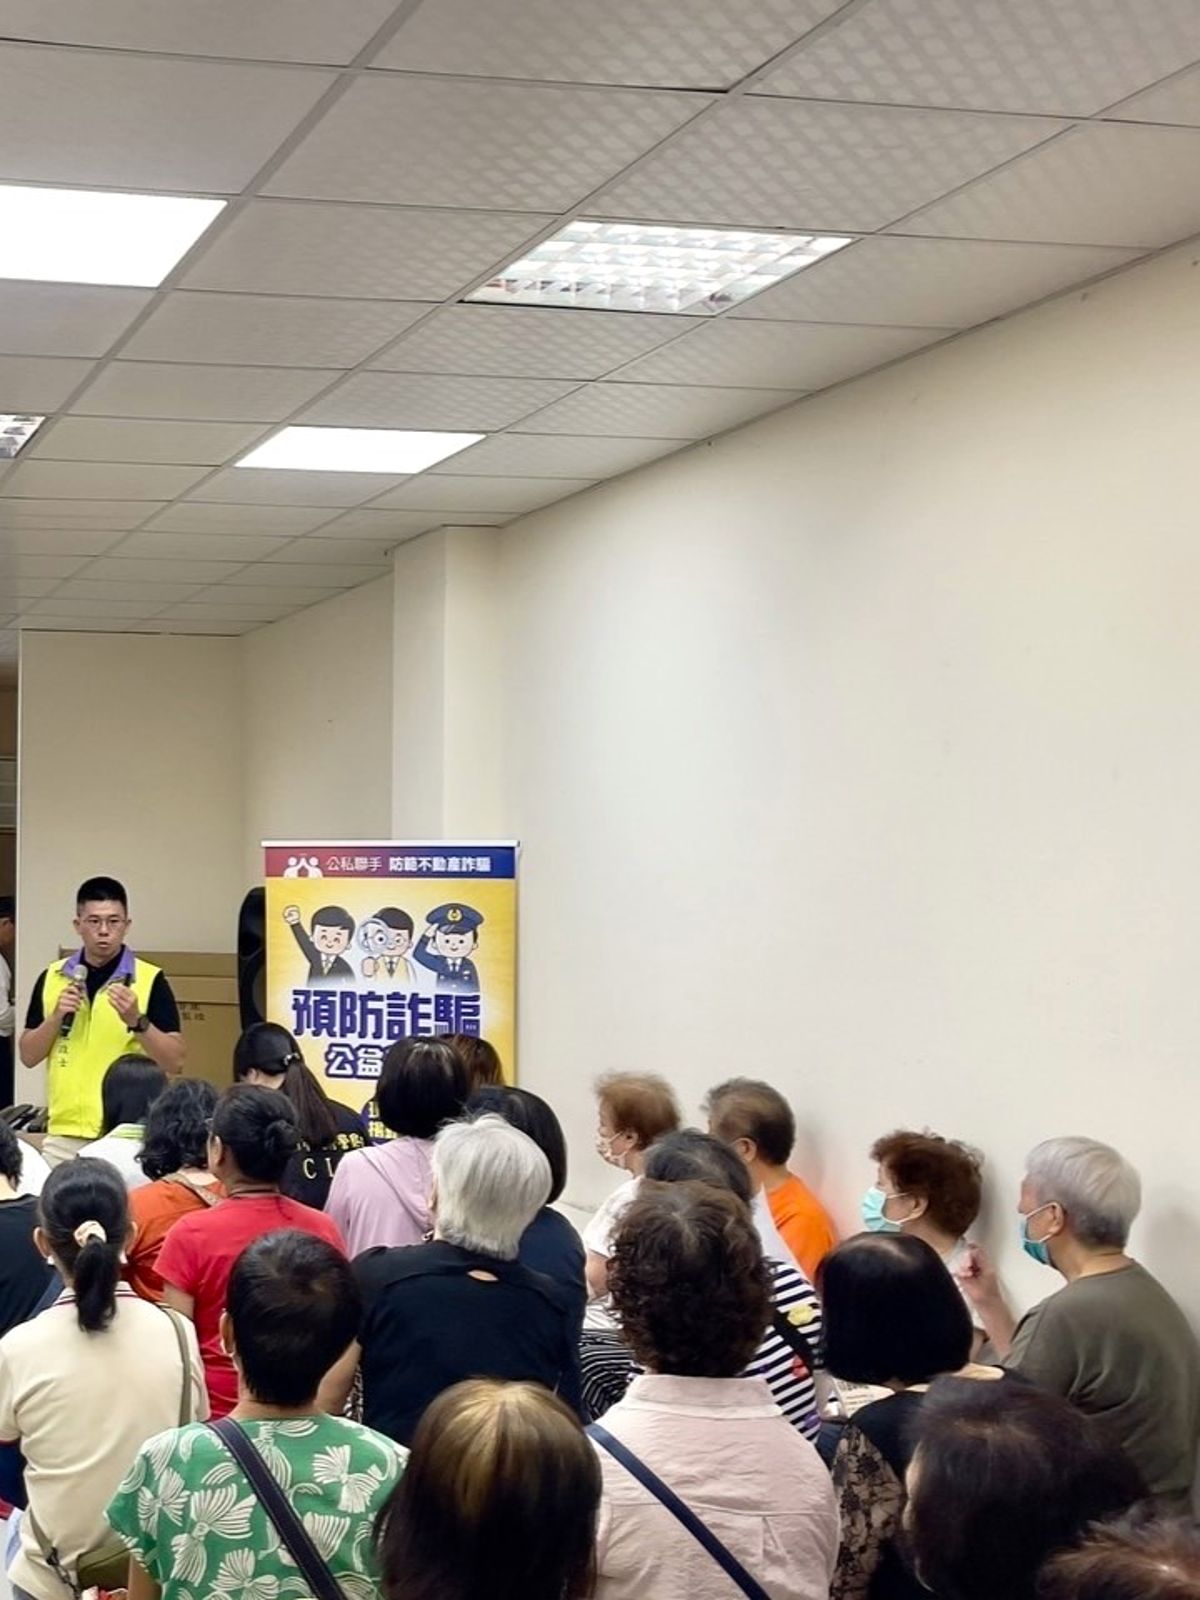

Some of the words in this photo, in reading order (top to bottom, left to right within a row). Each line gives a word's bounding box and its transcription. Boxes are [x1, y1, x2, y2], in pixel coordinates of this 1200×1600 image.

[326, 856, 382, 872] 公私聯手
[389, 856, 491, 872] 防範不動產詐騙
[291, 989, 481, 1041] 預防詐騙
[325, 1044, 388, 1078] 公益
